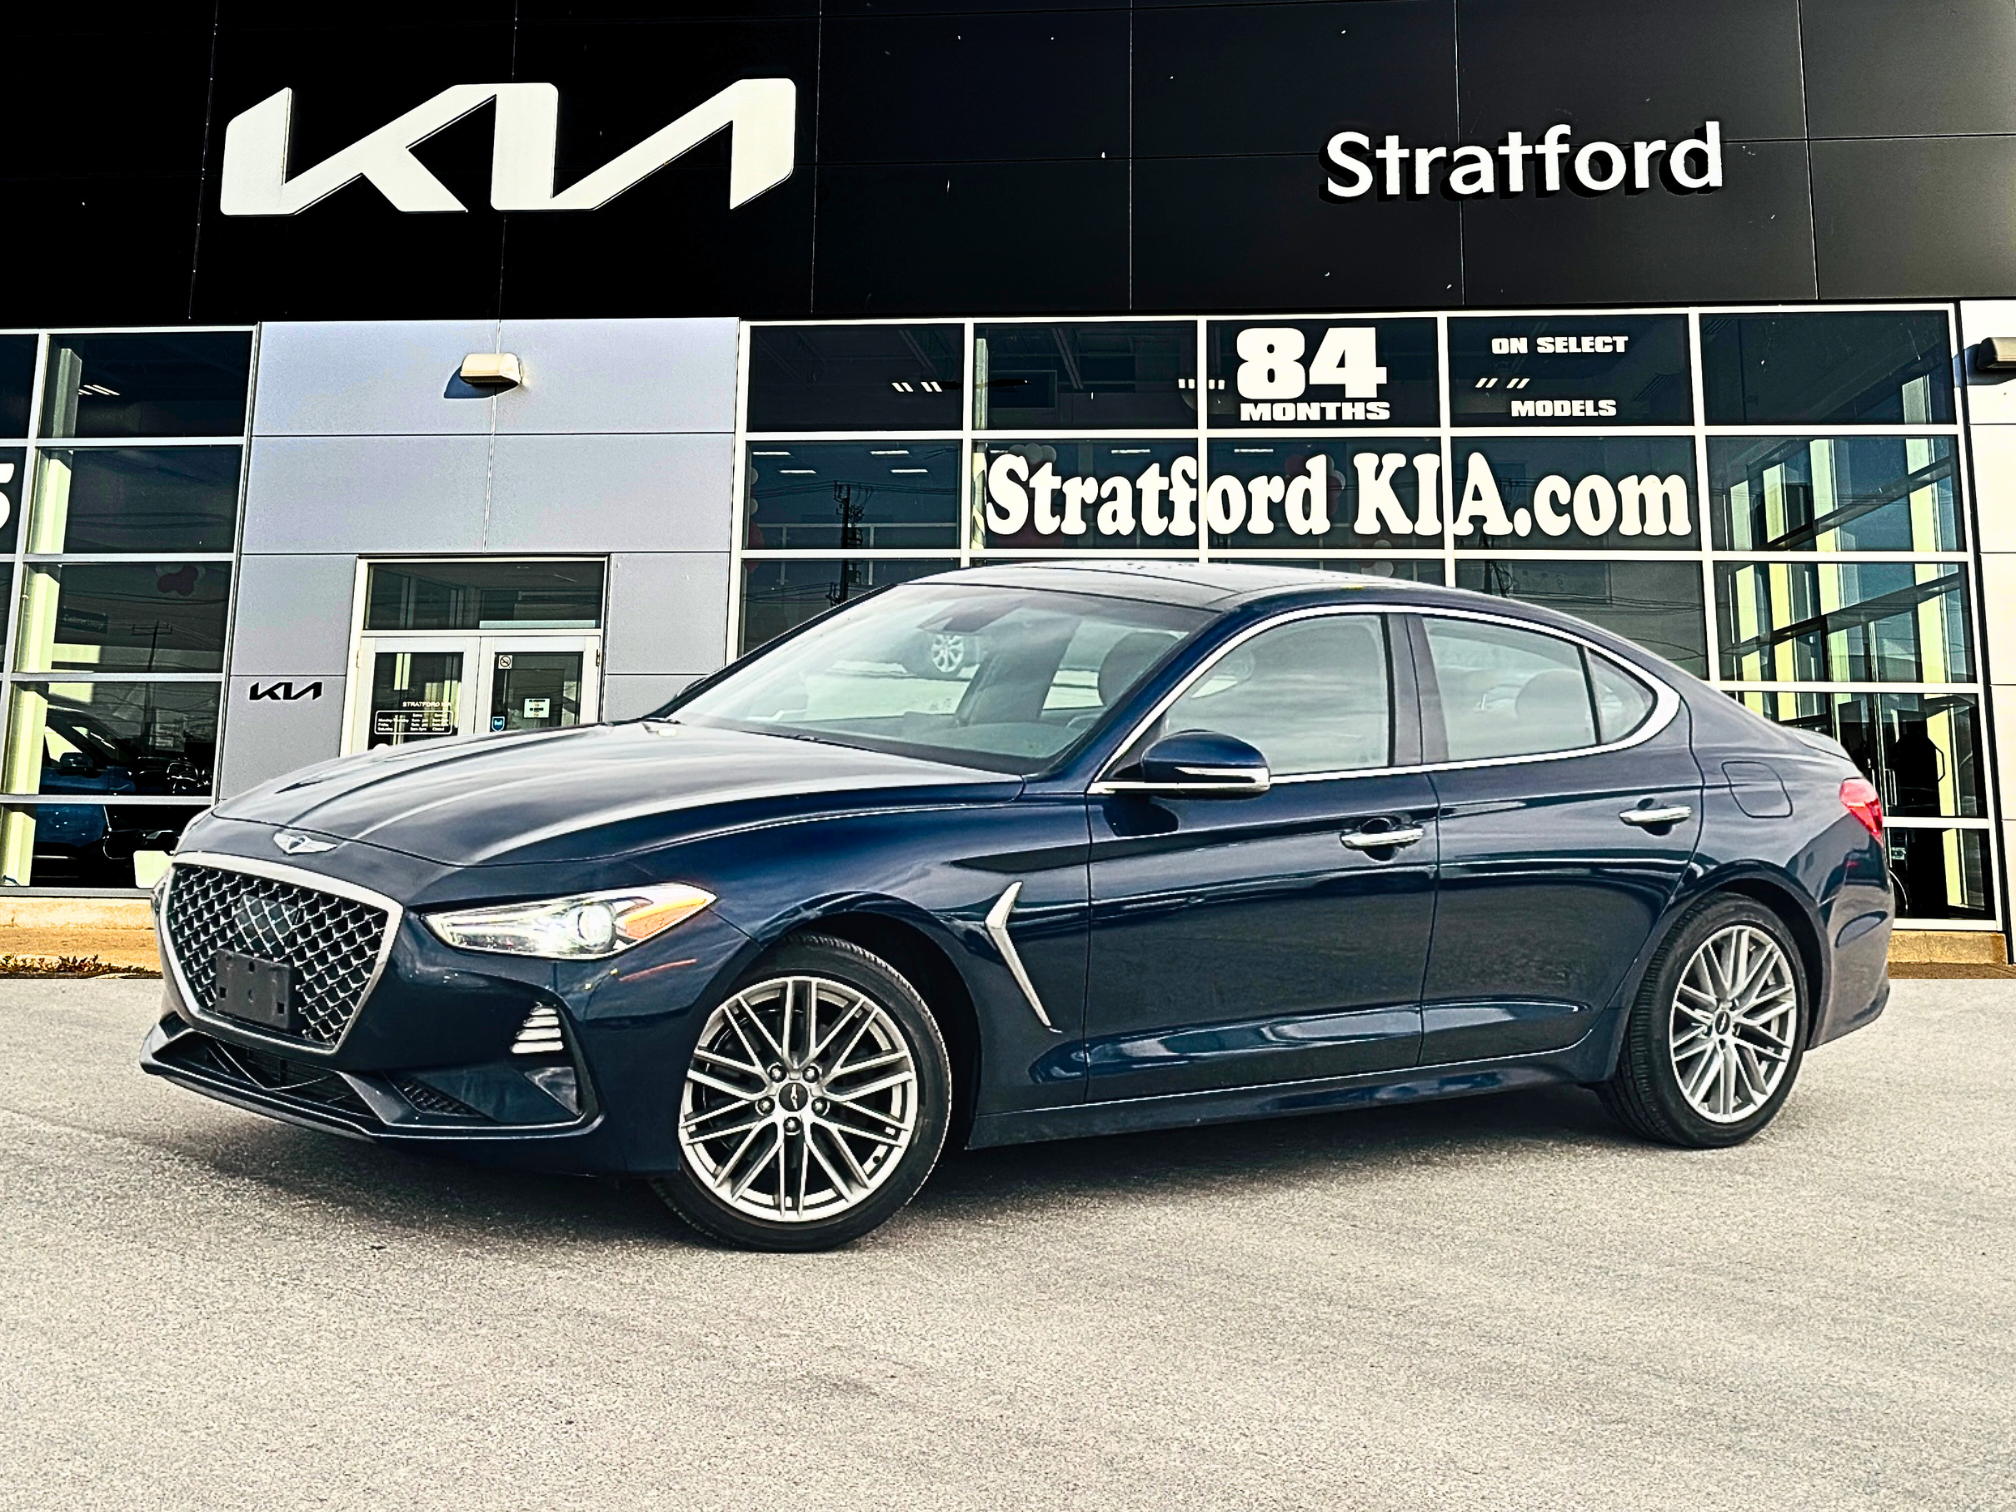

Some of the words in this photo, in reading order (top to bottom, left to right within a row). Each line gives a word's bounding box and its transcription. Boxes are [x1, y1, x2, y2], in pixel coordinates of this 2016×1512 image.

[220, 78, 797, 216] KIA
[1326, 120, 1723, 198] Stratford
[1236, 326, 1388, 400] 84
[1491, 337, 1529, 355] ON
[1536, 335, 1629, 354] SELECT
[1240, 401, 1391, 421] MONTHS
[1511, 399, 1617, 417] MODELS
[985, 452, 1332, 536] Stratford
[1353, 451, 1692, 537] KIA.com
[249, 681, 322, 701] KIA
